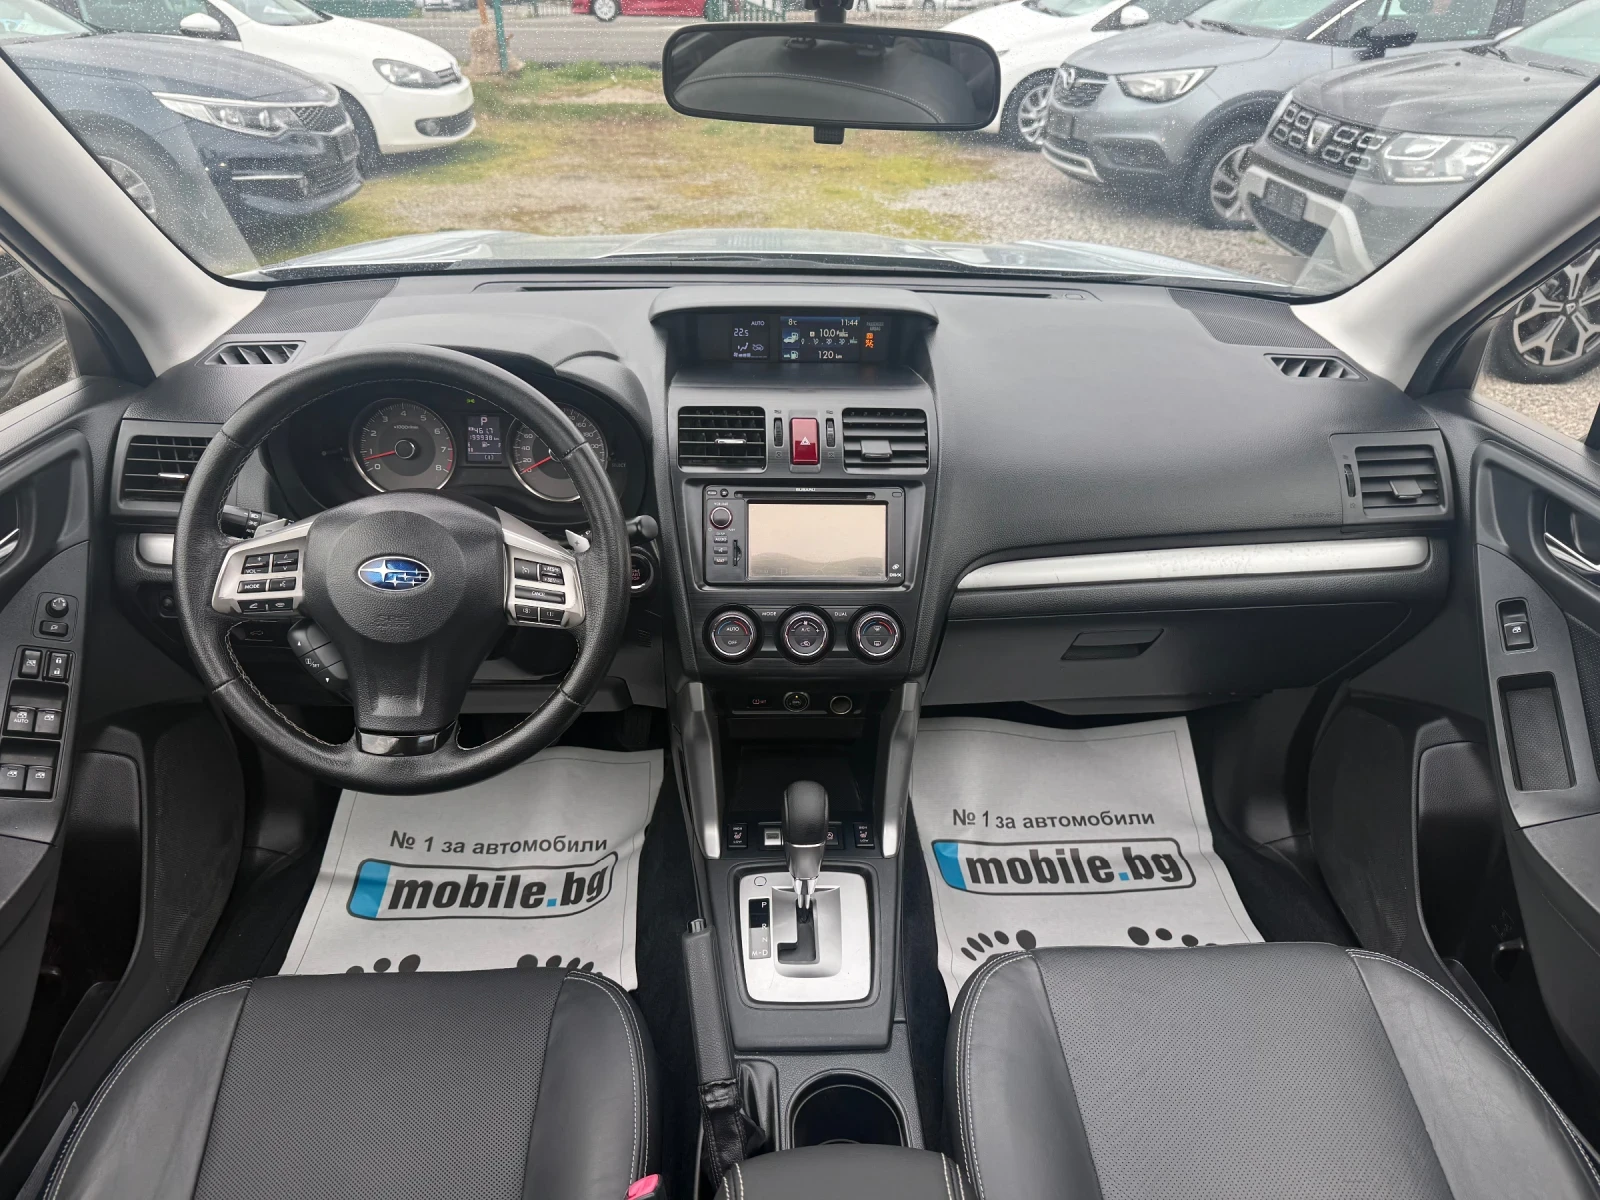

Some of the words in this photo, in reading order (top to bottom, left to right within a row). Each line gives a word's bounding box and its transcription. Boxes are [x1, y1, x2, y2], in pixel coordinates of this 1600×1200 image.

[840, 318, 858, 326] 11:44
[733, 327, 749, 337] 22.5
[818, 350, 834, 359] 120
[480, 416, 488, 426] P
[982, 811, 989, 828] 1
[995, 816, 1016, 829] за
[1023, 810, 1155, 829] автомобили
[424, 837, 434, 853] 1
[441, 841, 465, 854] за
[472, 835, 608, 855] автомобили
[965, 846, 1183, 885] mobile.bg
[387, 864, 609, 910] mobile.bg
